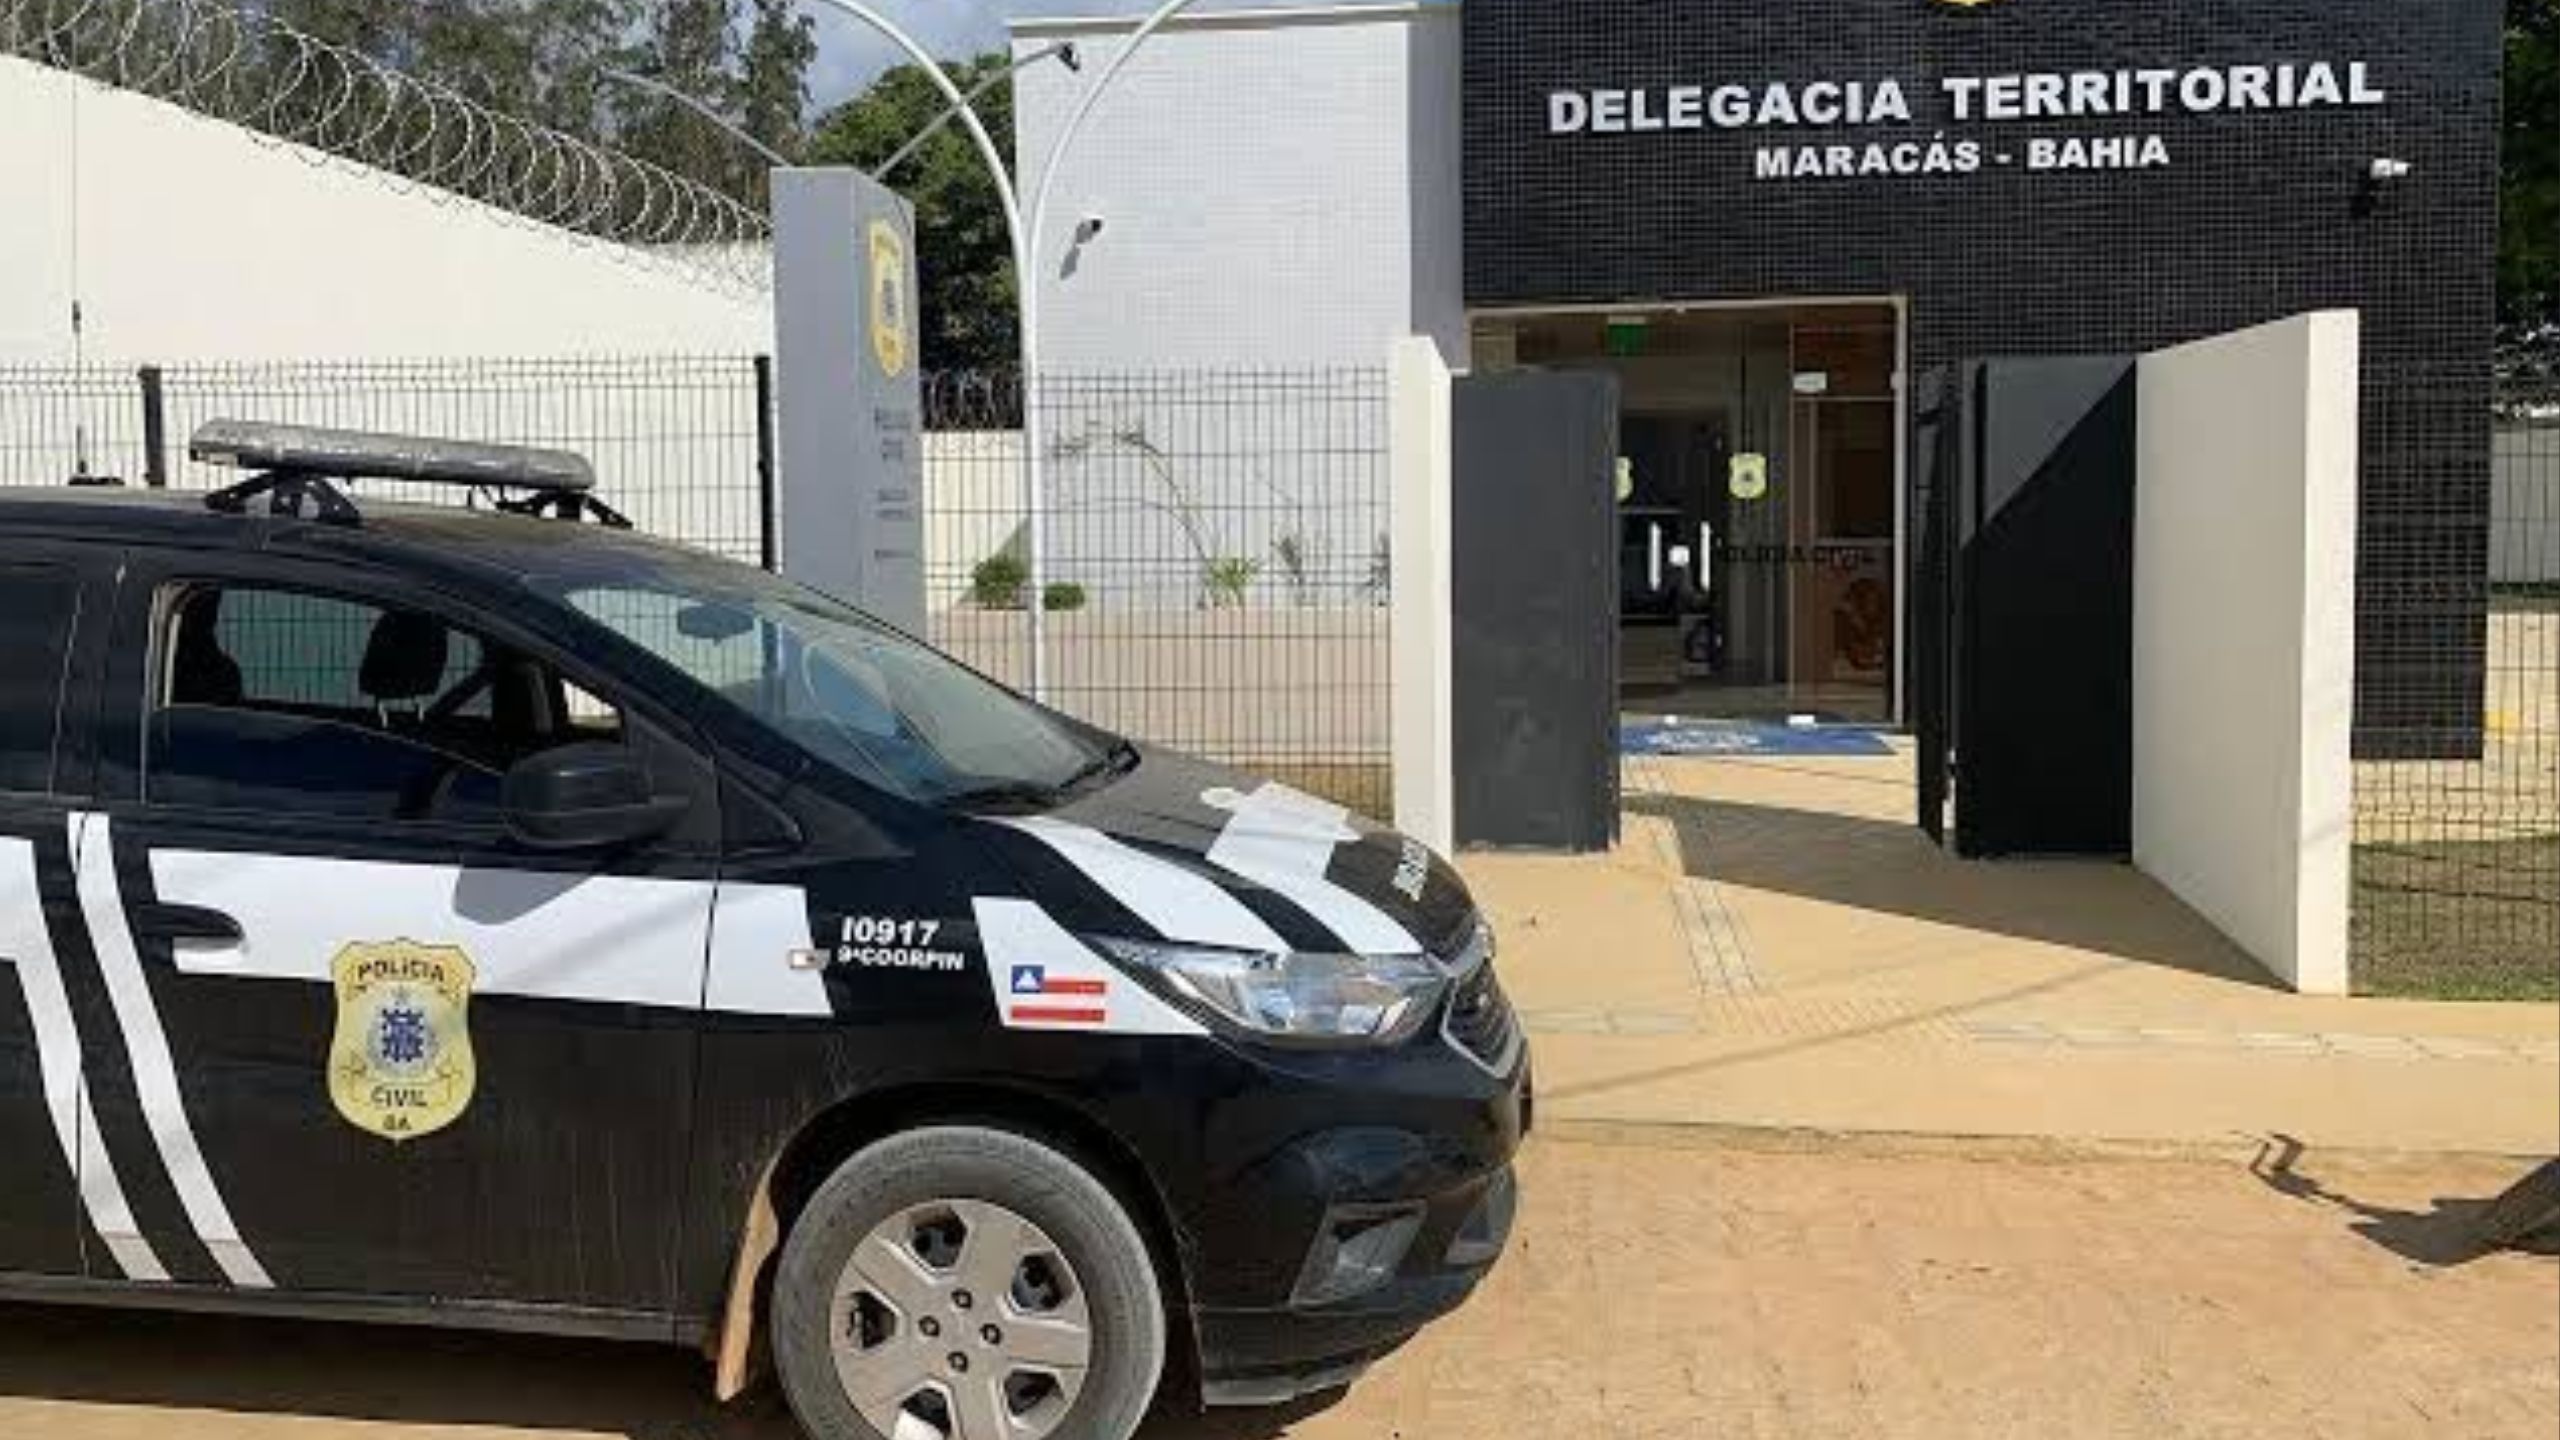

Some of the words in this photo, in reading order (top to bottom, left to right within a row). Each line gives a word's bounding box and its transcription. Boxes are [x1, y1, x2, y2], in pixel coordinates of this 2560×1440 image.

[1548, 79, 1912, 133] DELEGACIA
[1942, 61, 2385, 120] TERRITORIAL
[1756, 130, 1981, 180] MARACÁS
[2027, 134, 2171, 169] BAHIA
[371, 1084, 428, 1107] CIVIL
